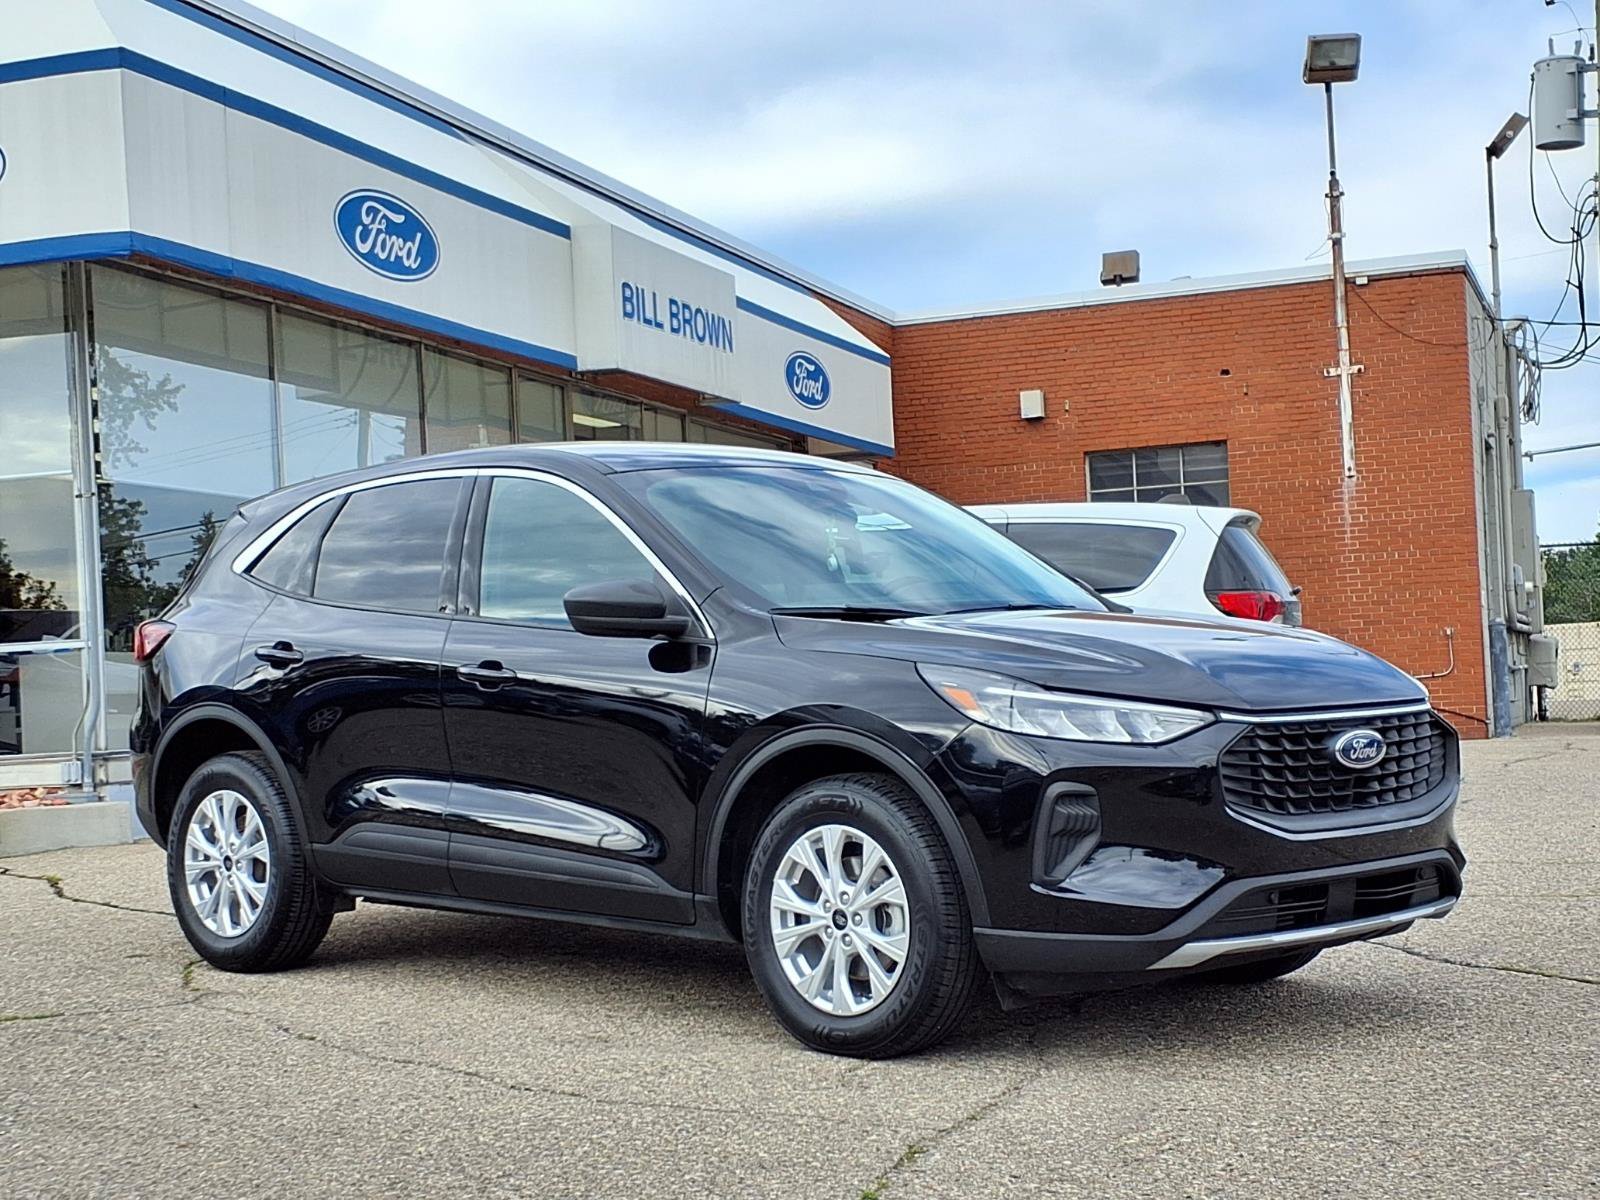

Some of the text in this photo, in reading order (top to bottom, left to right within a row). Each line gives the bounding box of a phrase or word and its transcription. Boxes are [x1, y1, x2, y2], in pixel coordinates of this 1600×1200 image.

[355, 201, 421, 269] Ford
[621, 282, 733, 353] BILL BROWN
[794, 359, 823, 400] Ford
[1350, 738, 1378, 759] Ford
